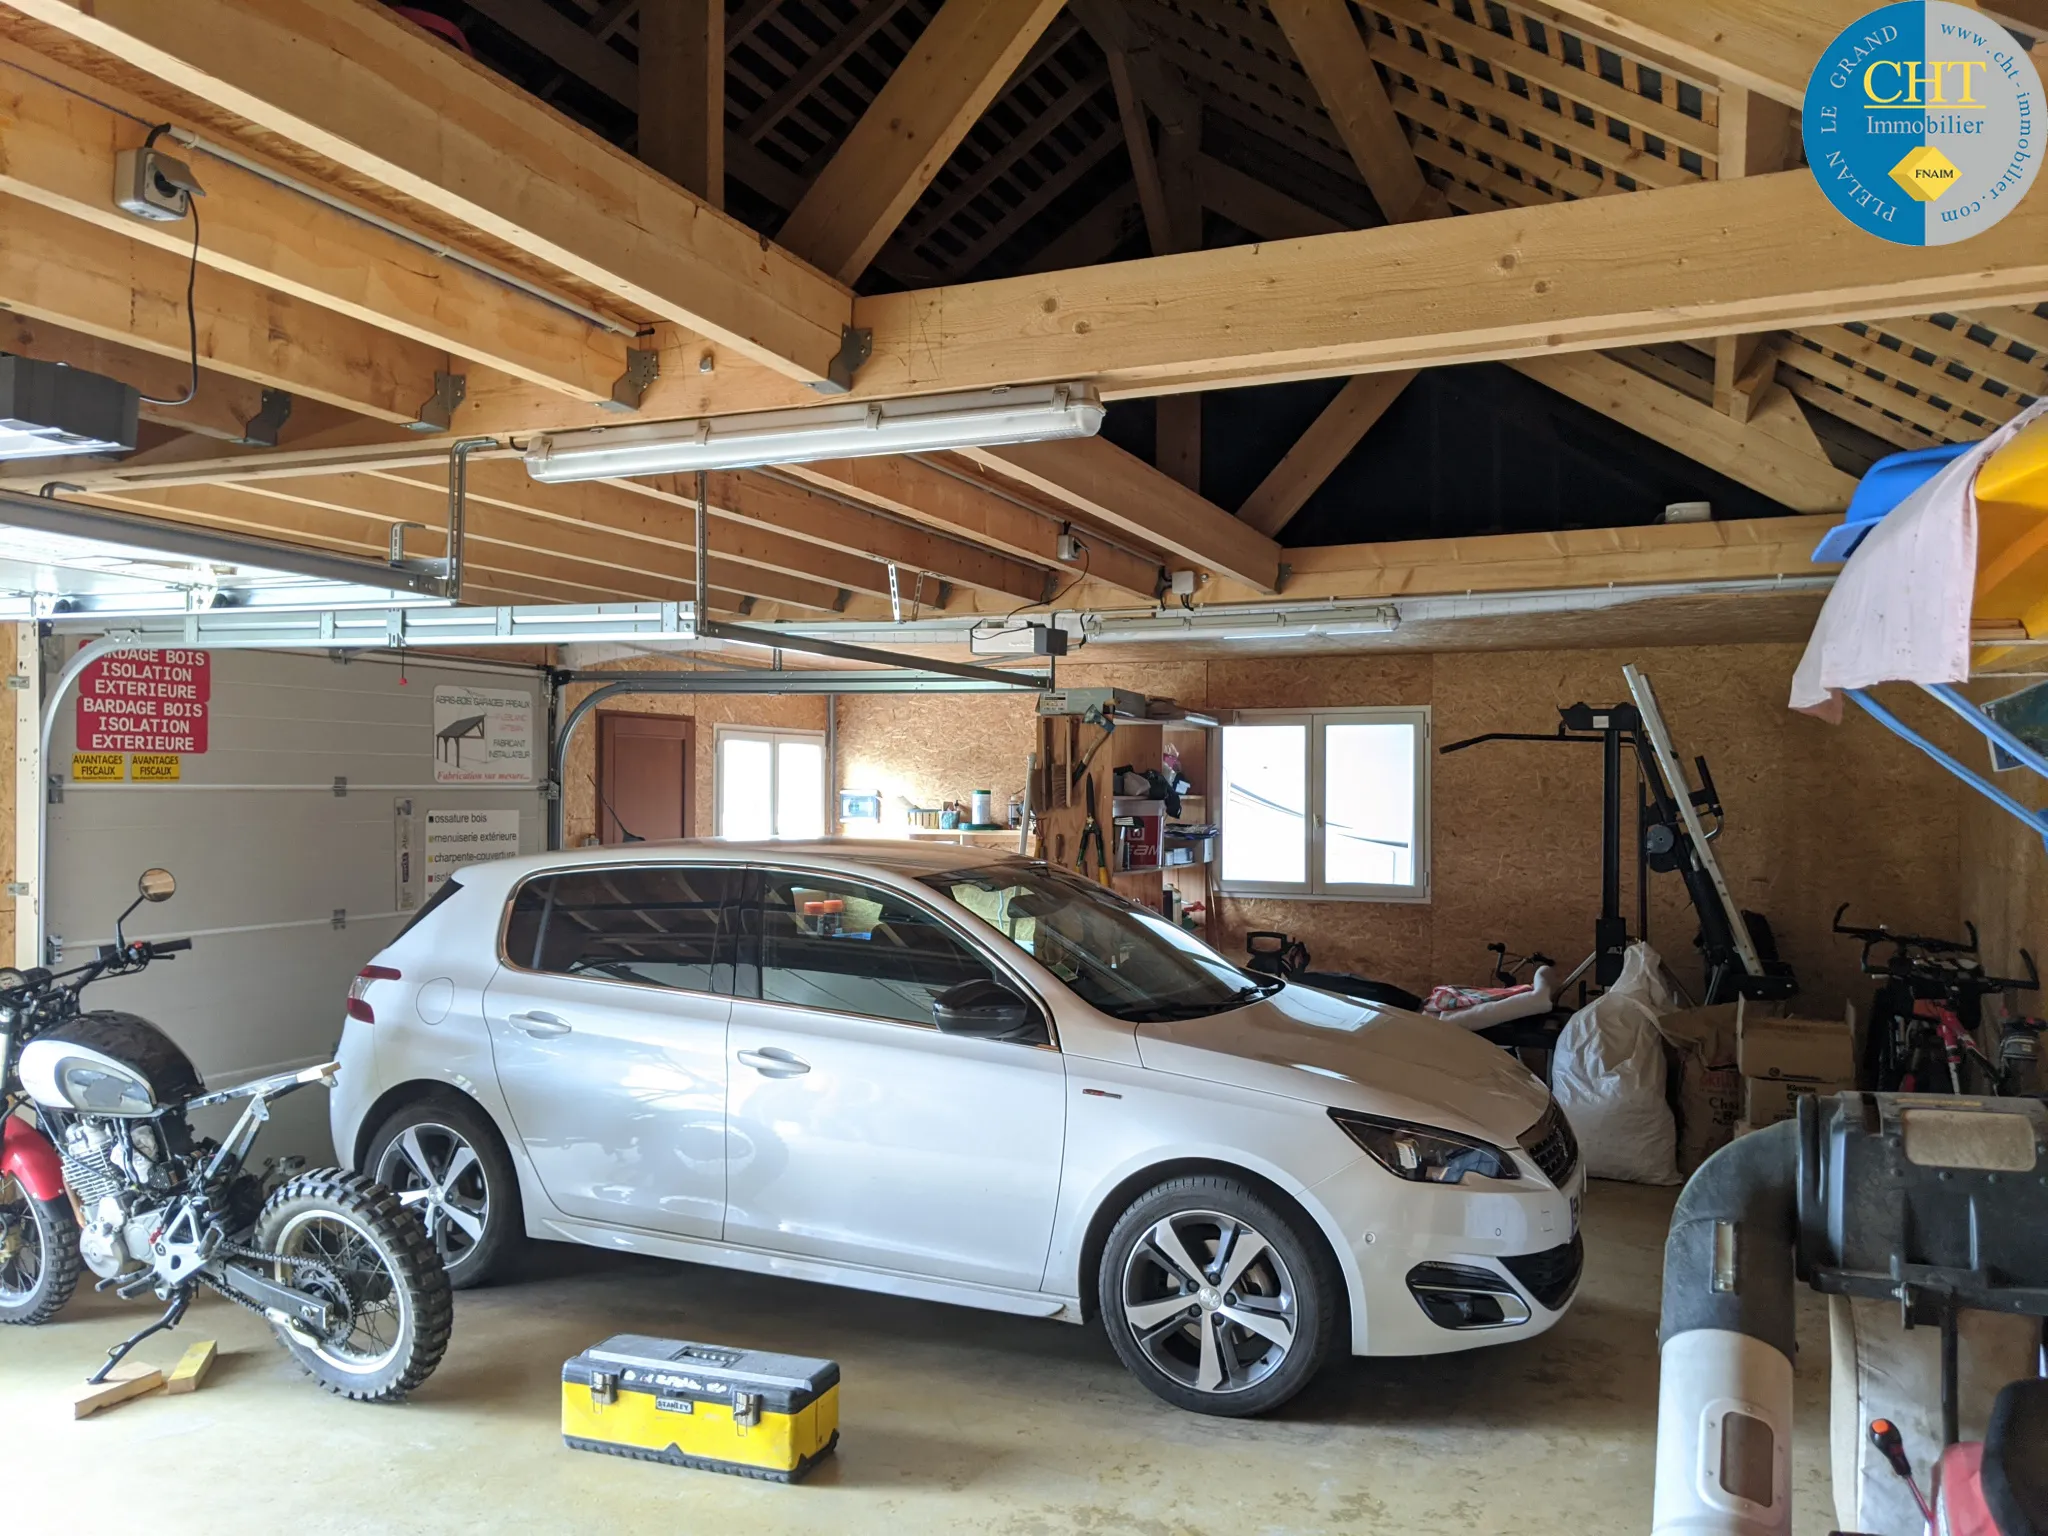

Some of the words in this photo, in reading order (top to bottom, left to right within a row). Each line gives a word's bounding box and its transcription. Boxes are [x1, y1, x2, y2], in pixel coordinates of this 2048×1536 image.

[165, 650, 205, 666] BOIS
[101, 661, 192, 682] ISOLATION
[95, 679, 197, 699] EXTERIEURE
[83, 698, 157, 715] BARDAGE
[163, 702, 203, 717] BOIS
[98, 716, 190, 734] ISOLATION
[92, 734, 195, 751] EXTERIEURE
[73, 755, 123, 765] AVANTAGES
[132, 756, 179, 765] AVANTAGES
[81, 766, 116, 775] FISCAUX
[139, 766, 172, 775] FISCAUX
[437, 770, 482, 780] Fabrication
[434, 814, 469, 824] ossature
[471, 813, 487, 823] bois
[434, 832, 478, 843] menuiserie
[480, 832, 517, 842] extérieure
[657, 1400, 689, 1411] STANLEY
